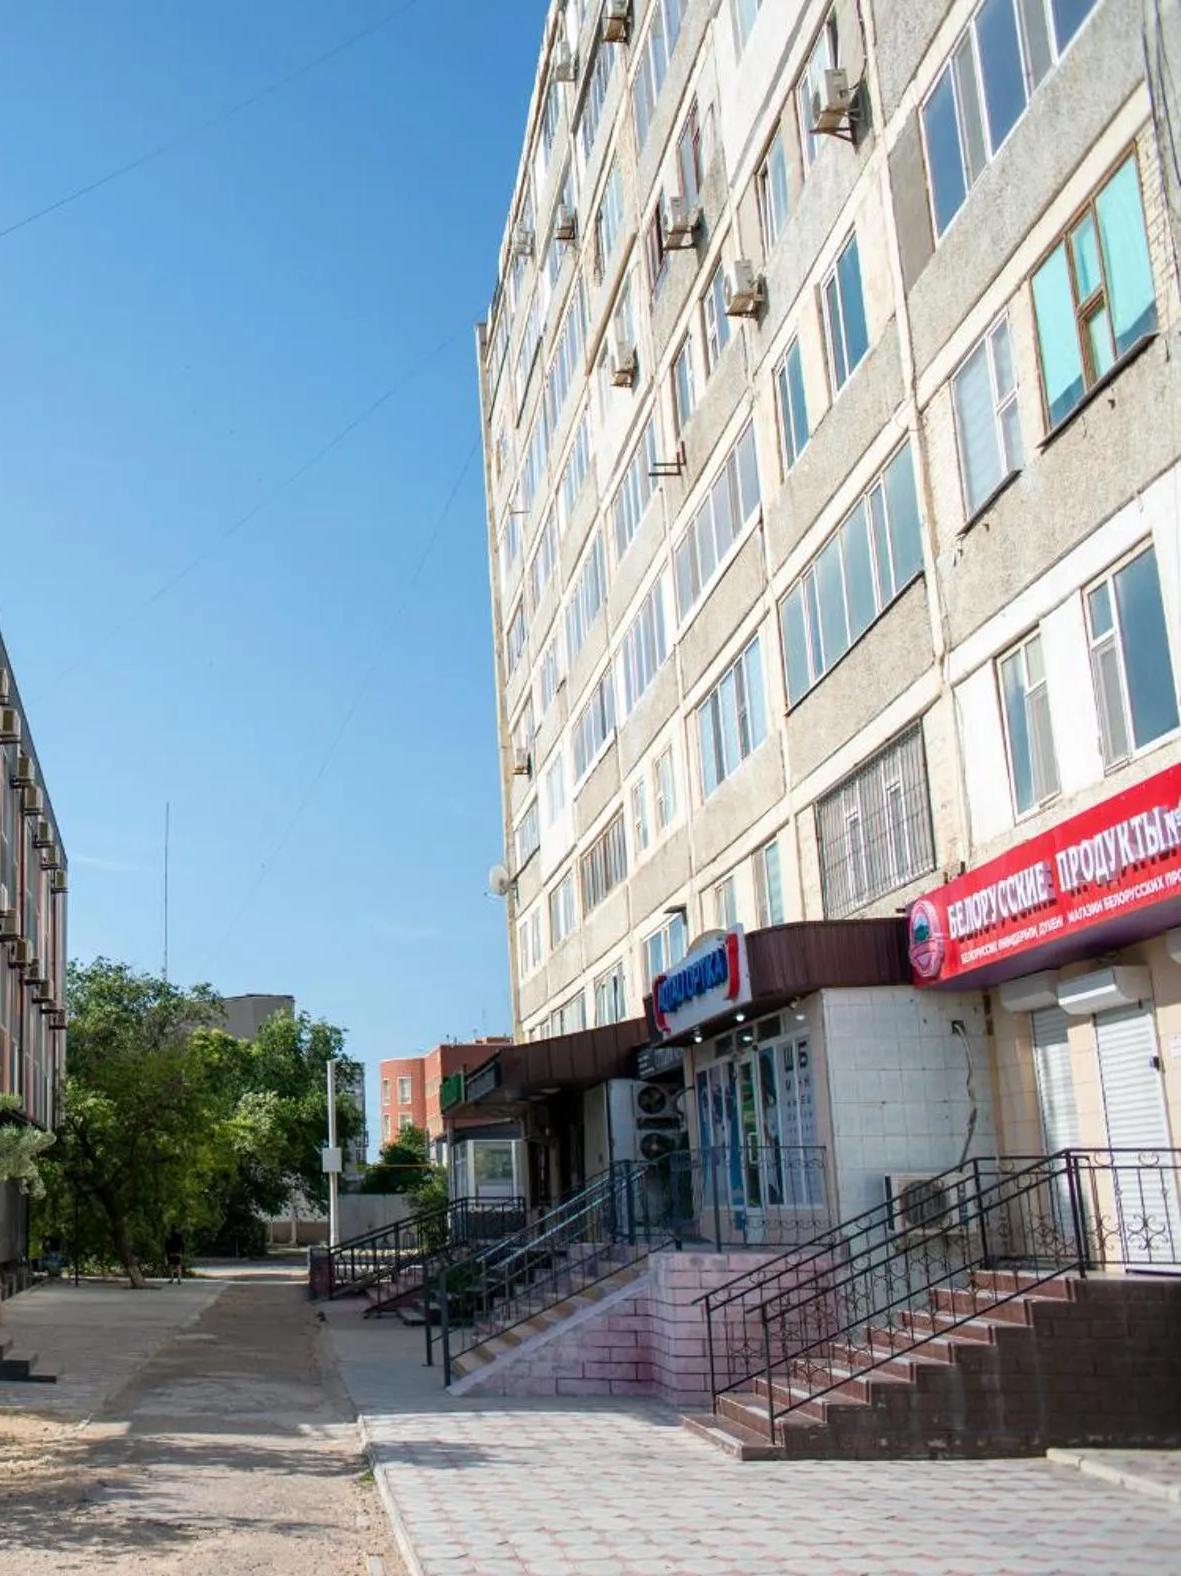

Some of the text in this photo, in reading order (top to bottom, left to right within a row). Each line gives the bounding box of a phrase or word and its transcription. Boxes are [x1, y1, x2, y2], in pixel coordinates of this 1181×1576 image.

[947, 861, 1048, 940] БЕЛОРУССКИЕ
[1055, 805, 1166, 893] ПРОДУКТЫ
[1103, 875, 1165, 910] БЕЛОРУССКИХ
[798, 1040, 808, 1068] Б
